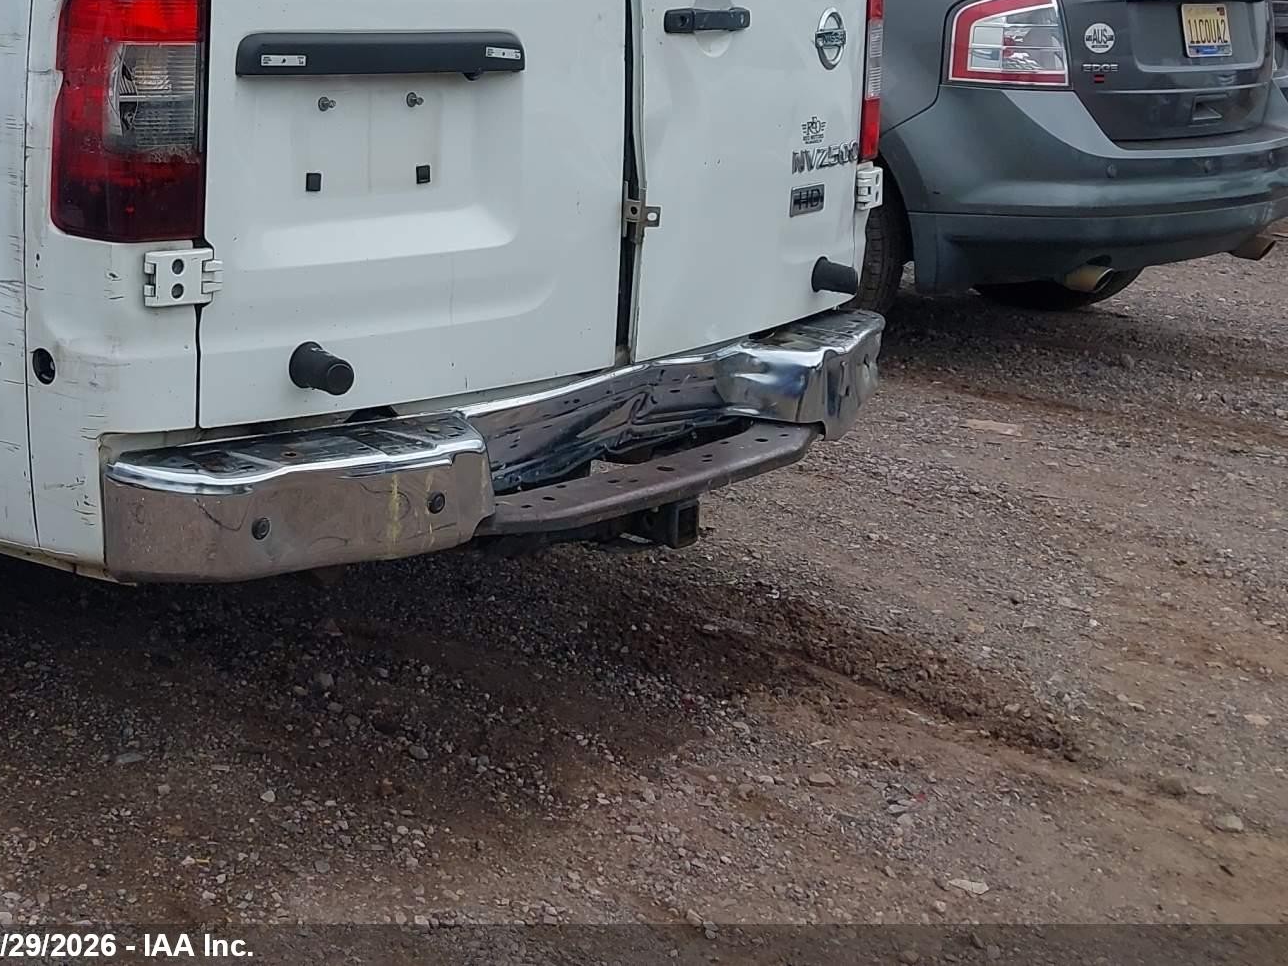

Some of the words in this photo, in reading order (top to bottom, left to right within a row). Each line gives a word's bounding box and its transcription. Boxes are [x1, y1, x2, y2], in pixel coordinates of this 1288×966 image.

[1092, 28, 1108, 44] AUS
[1082, 63, 1119, 72] EDGE
[798, 188, 821, 210] HD
